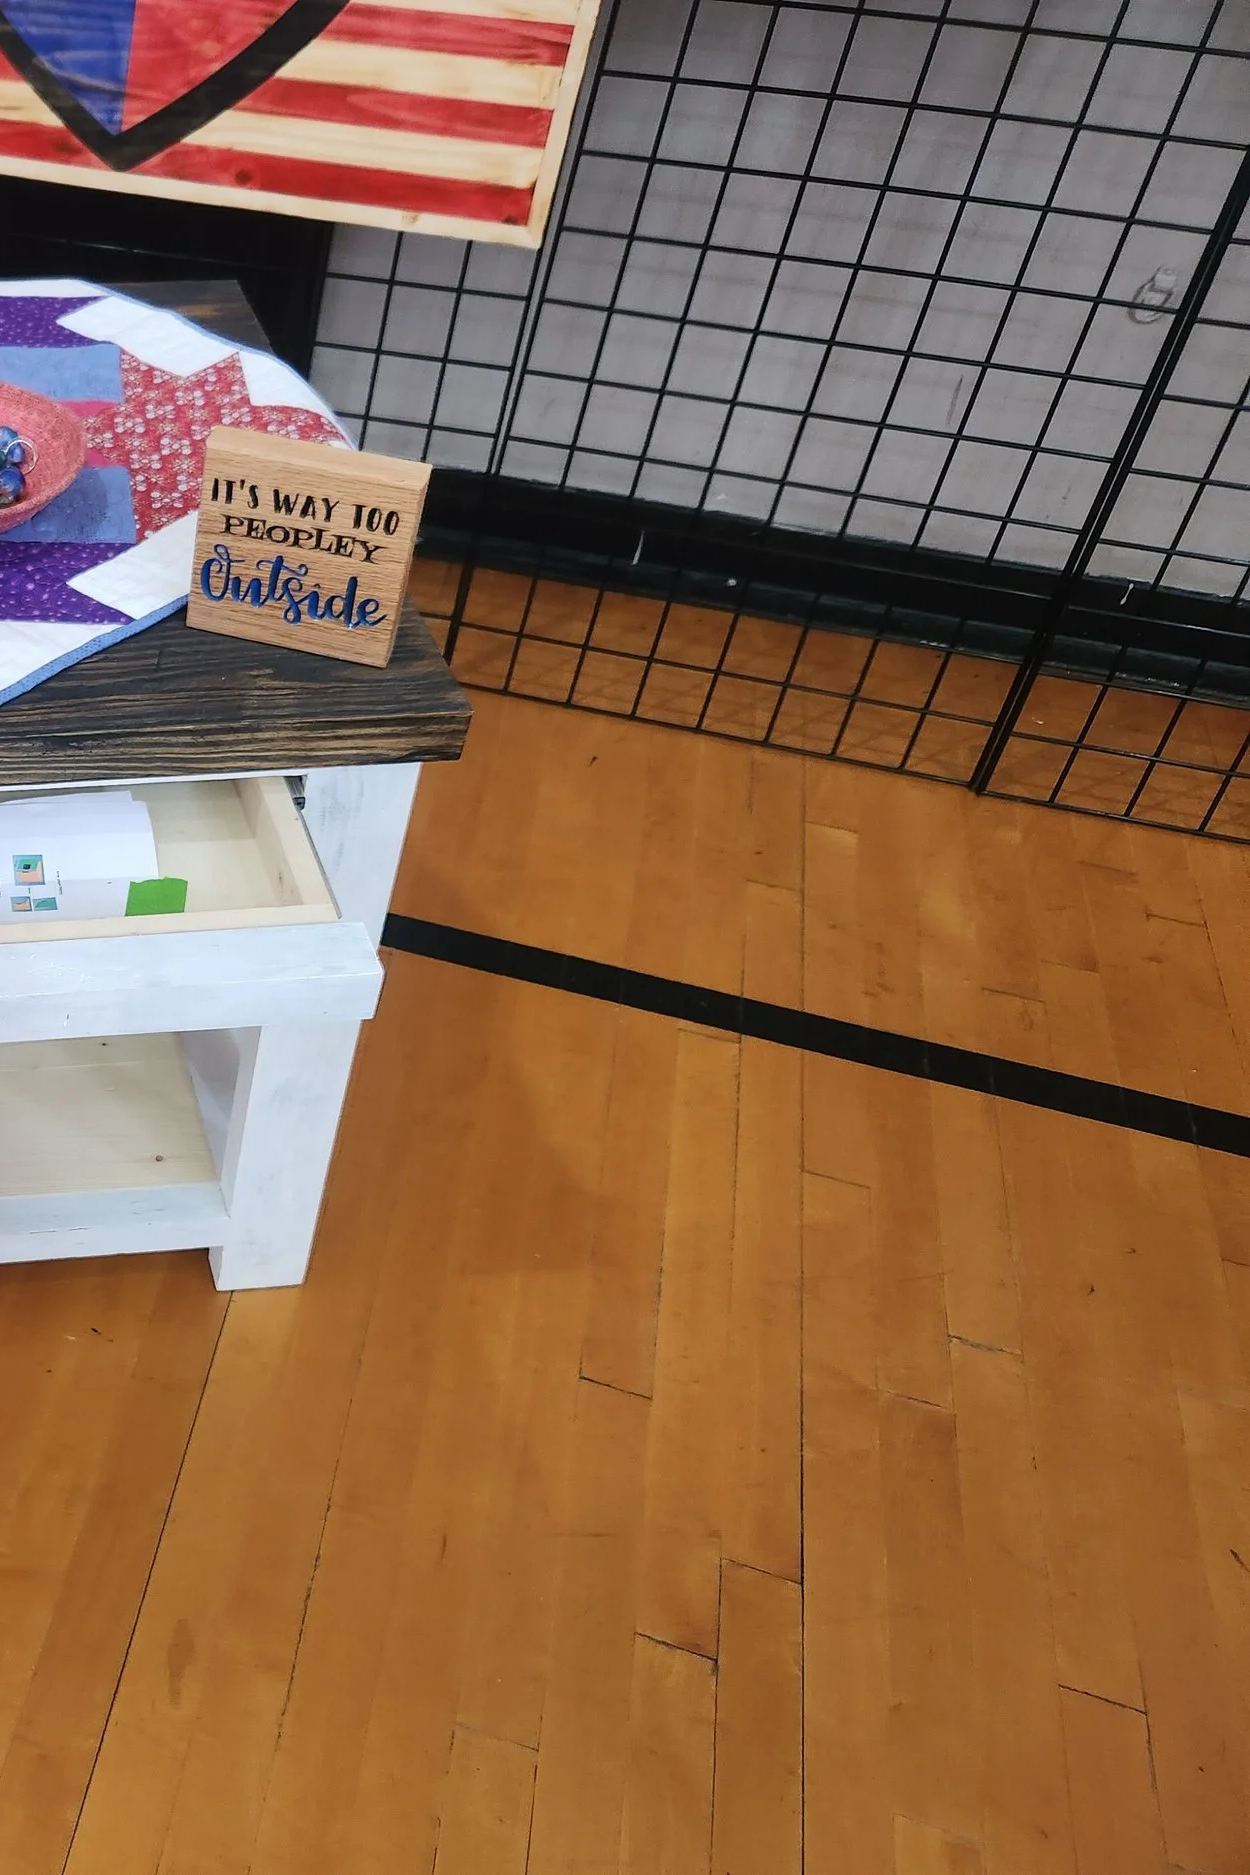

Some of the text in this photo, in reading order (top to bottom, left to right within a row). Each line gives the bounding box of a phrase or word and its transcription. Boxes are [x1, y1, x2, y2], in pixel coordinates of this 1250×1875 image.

[211, 478, 401, 536] IT'S WAY TOO
[219, 514, 388, 564] PEOPLEY
[200, 543, 388, 629] Outside
